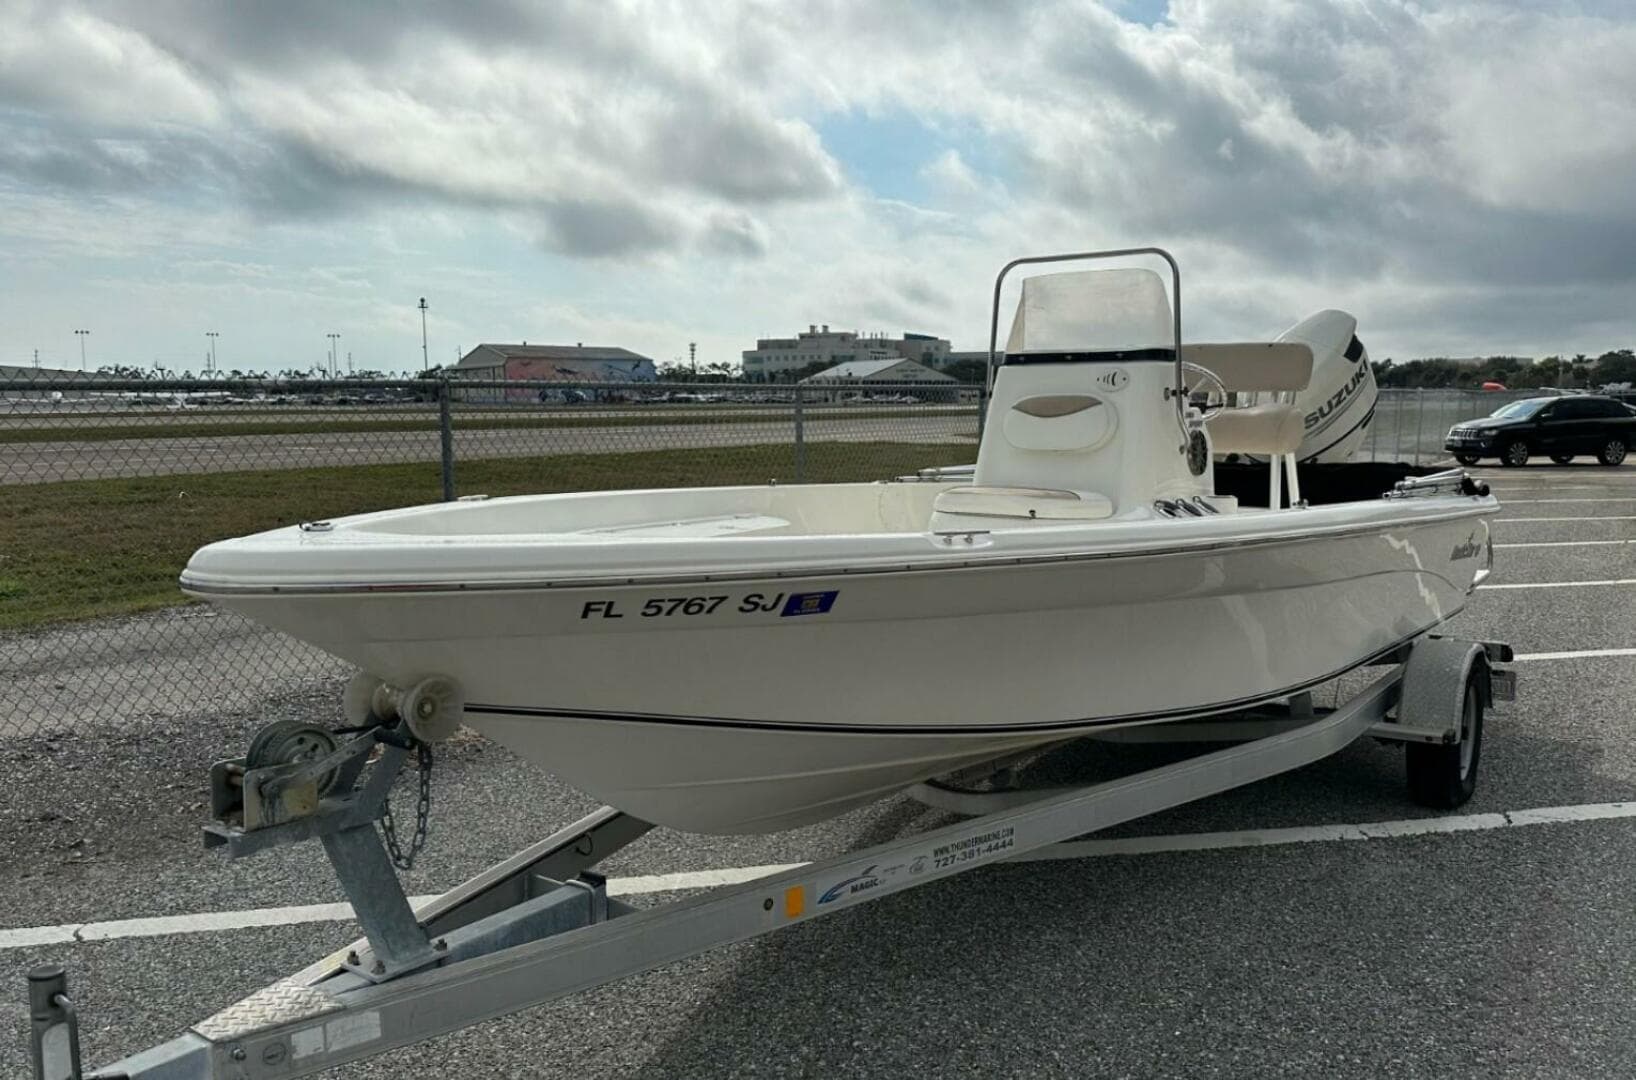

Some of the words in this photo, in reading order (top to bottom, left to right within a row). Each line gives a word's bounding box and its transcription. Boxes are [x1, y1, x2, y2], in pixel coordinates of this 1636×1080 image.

[1304, 359, 1368, 430] SUZUKI
[581, 601, 624, 619] FL
[641, 596, 729, 617] 5767
[738, 593, 784, 613] SJ
[851, 879, 879, 894] MAGIC
